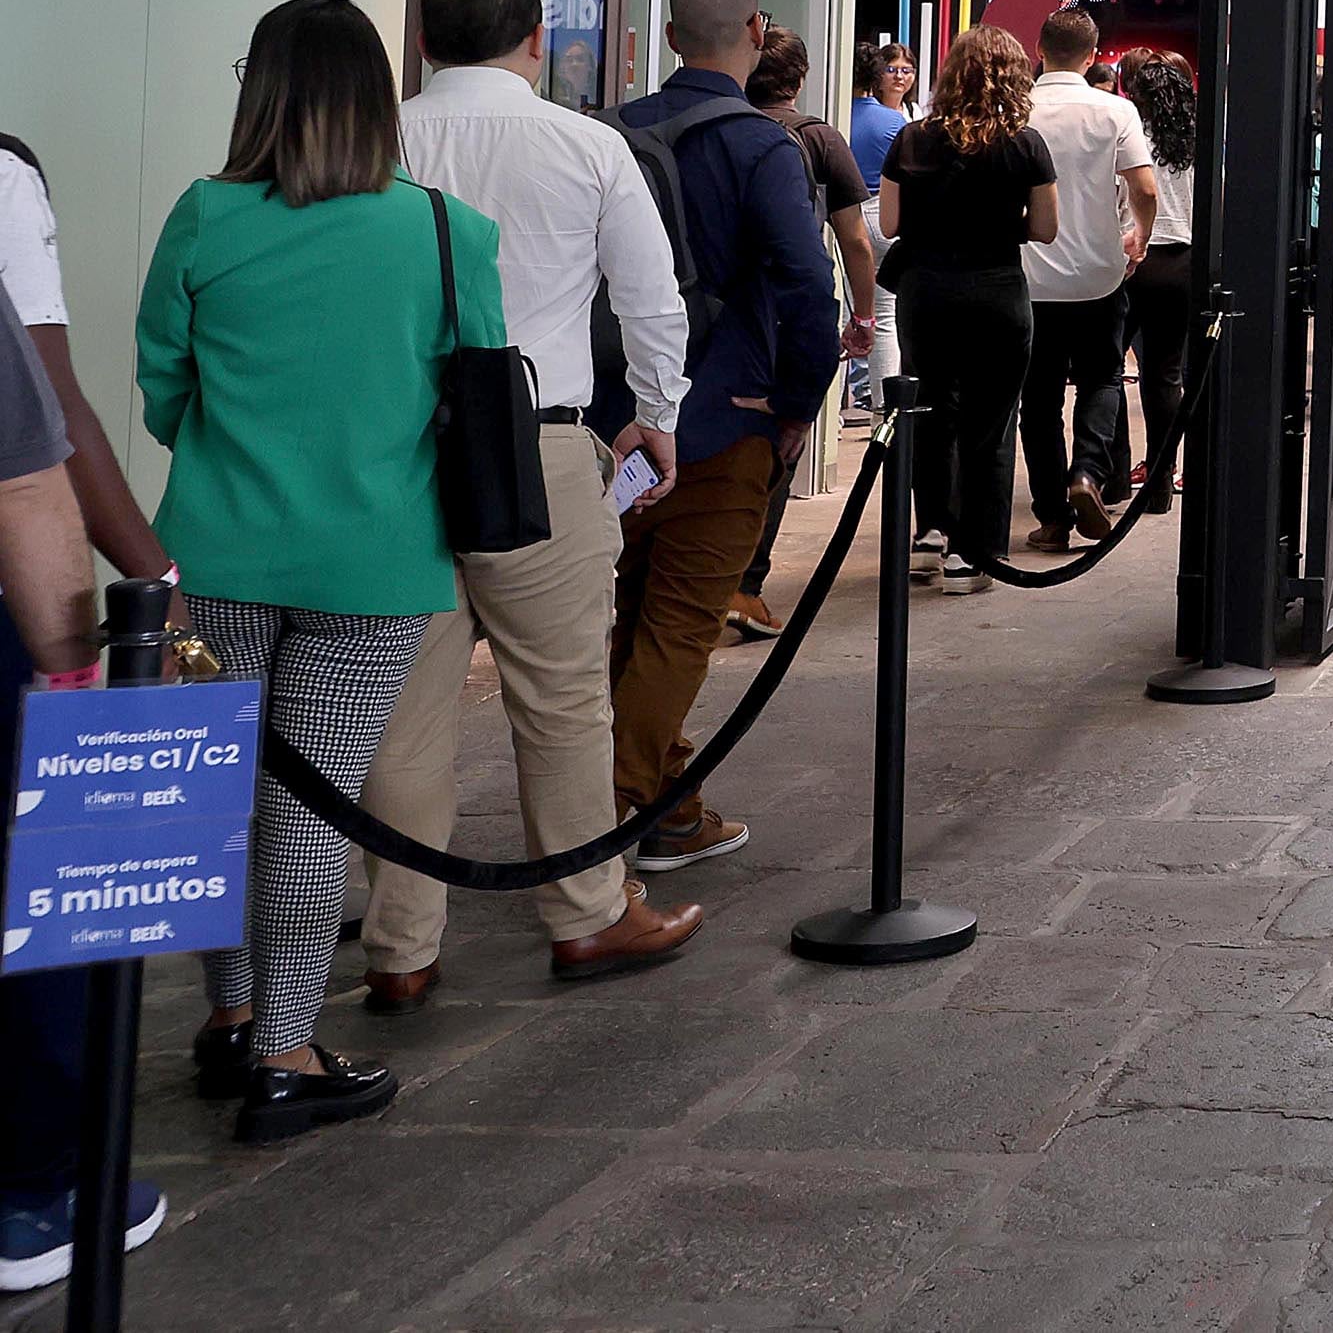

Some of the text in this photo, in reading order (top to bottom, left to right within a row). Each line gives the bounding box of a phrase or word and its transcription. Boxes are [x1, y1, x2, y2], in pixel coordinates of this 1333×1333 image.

[76, 726, 209, 747] Verificación Oral
[37, 750, 146, 779] Niveles
[56, 854, 199, 880] Tiempo de espera
[28, 875, 227, 918] 5 minutos
